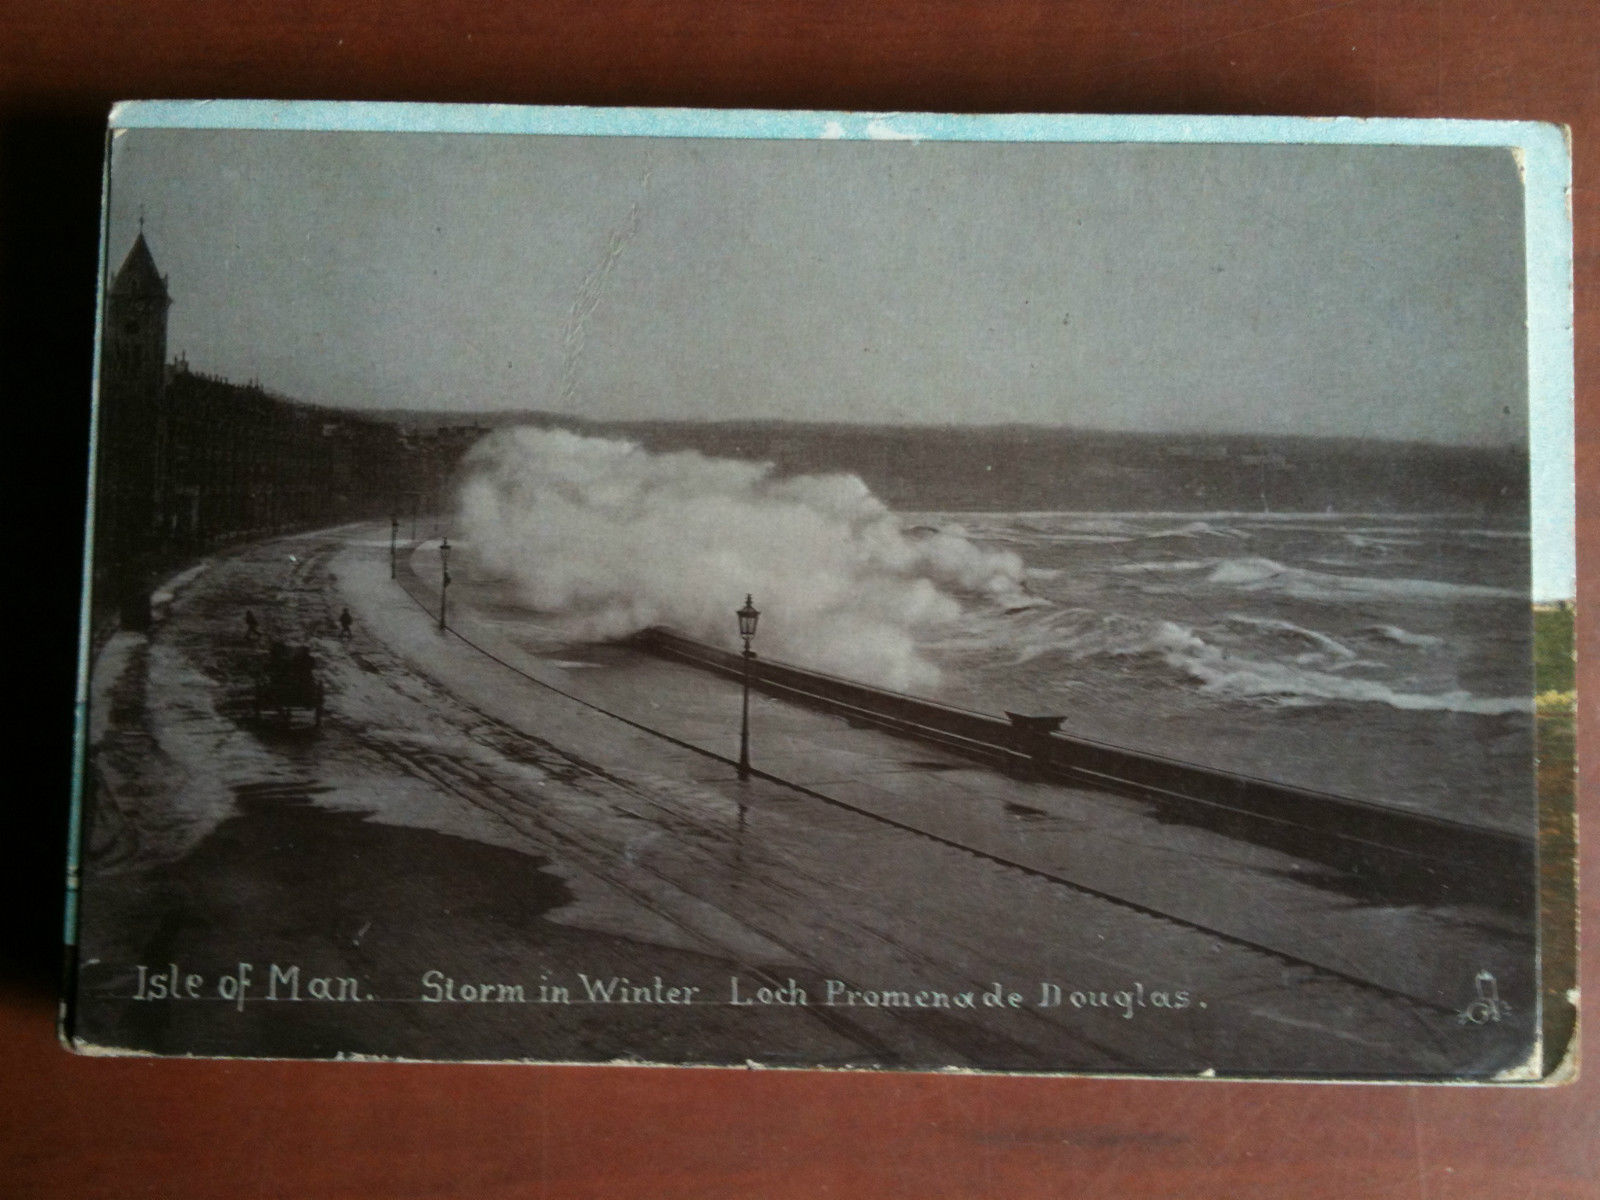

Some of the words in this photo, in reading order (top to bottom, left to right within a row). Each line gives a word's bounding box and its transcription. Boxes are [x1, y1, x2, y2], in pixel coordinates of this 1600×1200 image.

[132, 964, 204, 1003] Isle
[217, 961, 254, 1013] of
[265, 963, 375, 1004] Man.
[421, 969, 527, 1004] Storm
[539, 970, 571, 1005] in
[577, 972, 701, 1006] Winter
[729, 974, 809, 1007] Loch
[825, 979, 1023, 1009] Promenade
[1038, 981, 1208, 1020] Douglas.
